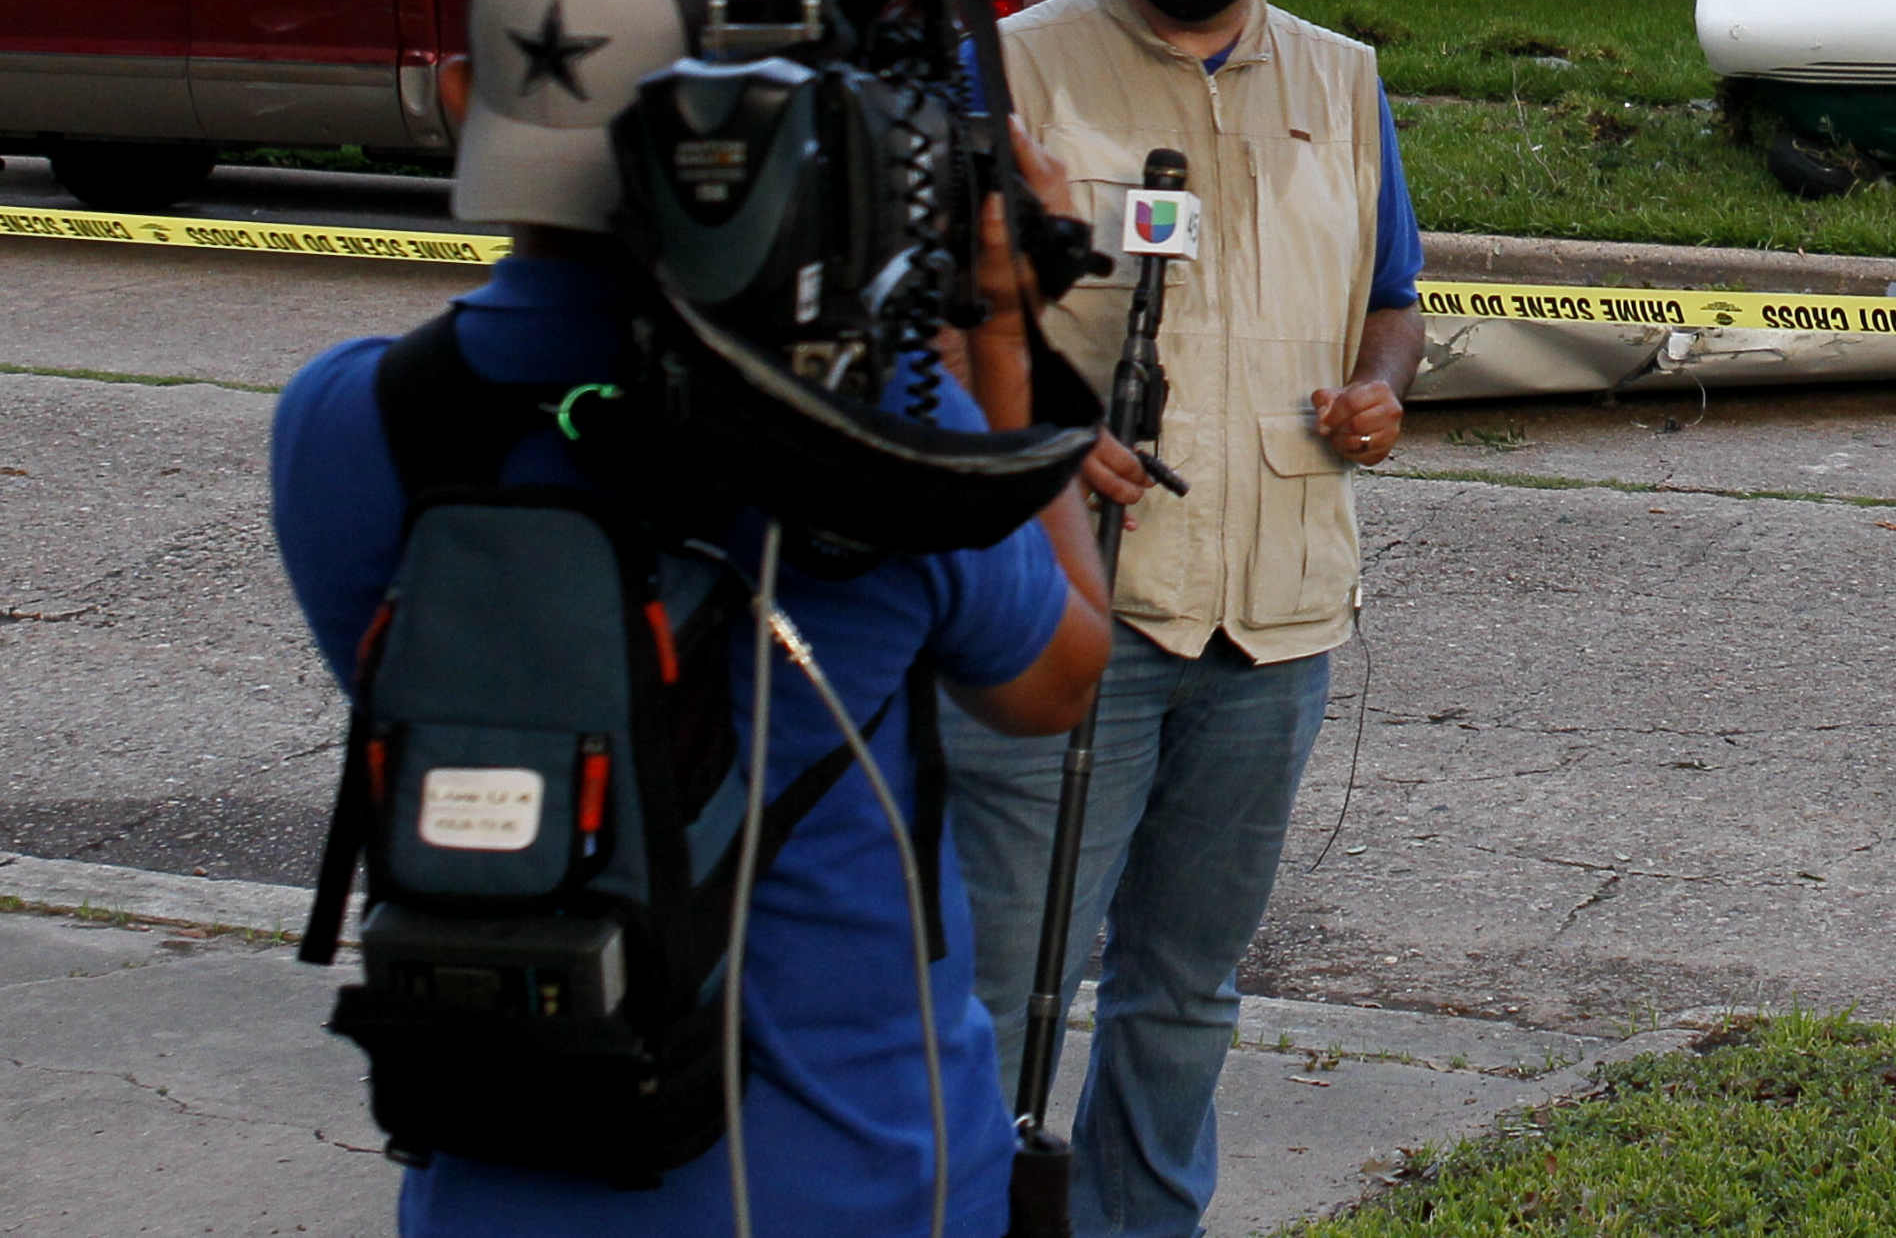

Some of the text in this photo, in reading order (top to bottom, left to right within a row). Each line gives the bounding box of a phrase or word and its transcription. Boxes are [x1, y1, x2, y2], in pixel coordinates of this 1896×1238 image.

[63, 217, 133, 240] CRIME
[186, 226, 482, 262] CRIME SCENE DO NOT CROSS
[1419, 292, 1464, 315] NOT
[1470, 293, 1508, 317] DO
[1511, 295, 1595, 321] SCENE
[1600, 298, 1685, 324] CRIME
[1762, 303, 1849, 331] CROSS
